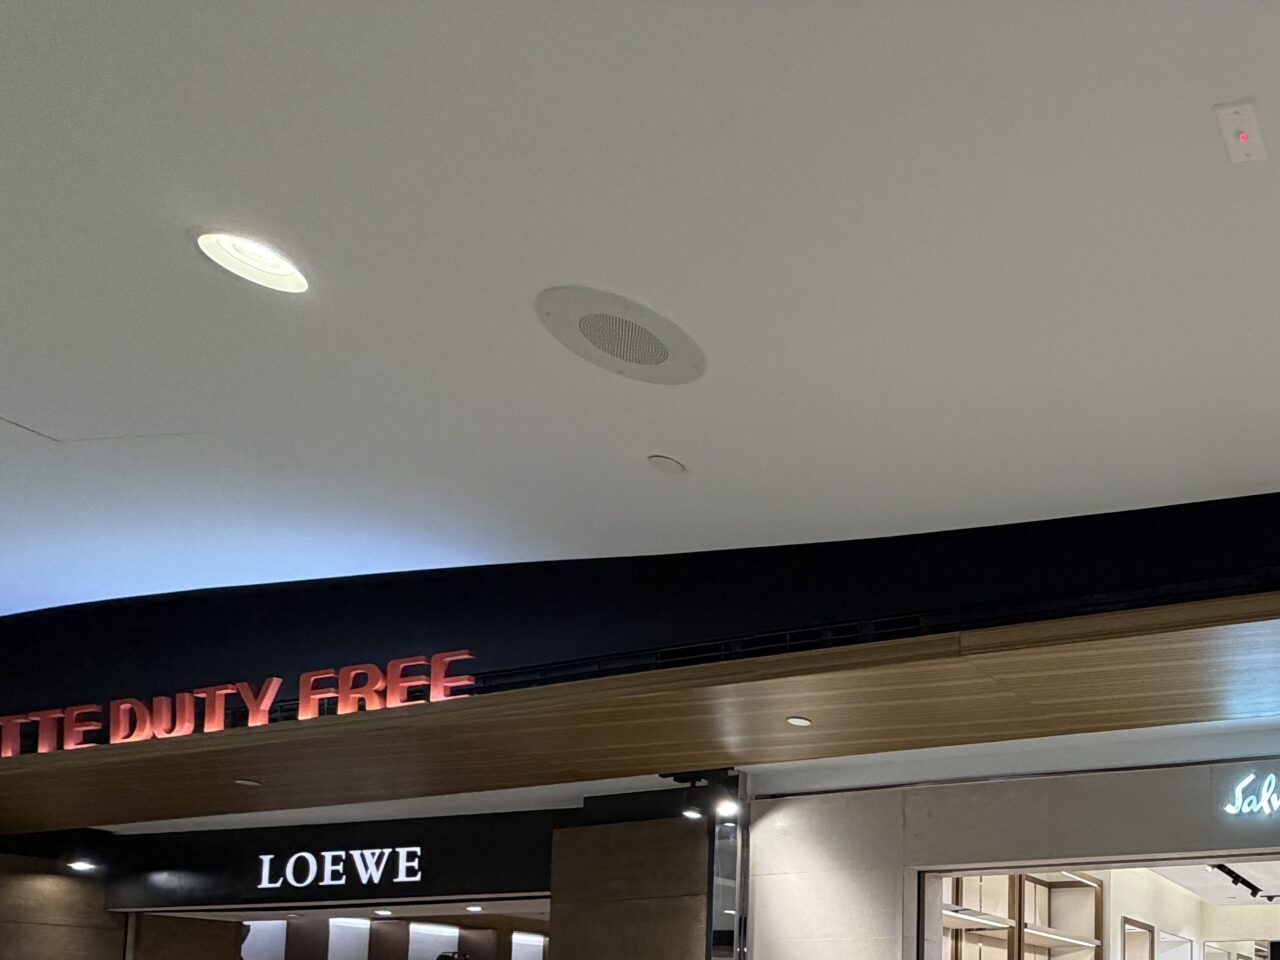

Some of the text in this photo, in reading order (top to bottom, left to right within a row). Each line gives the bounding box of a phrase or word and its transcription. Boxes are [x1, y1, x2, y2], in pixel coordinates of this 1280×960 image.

[109, 676, 283, 744] DUTY
[297, 649, 475, 720] FREE
[258, 846, 422, 888] LOEWE
